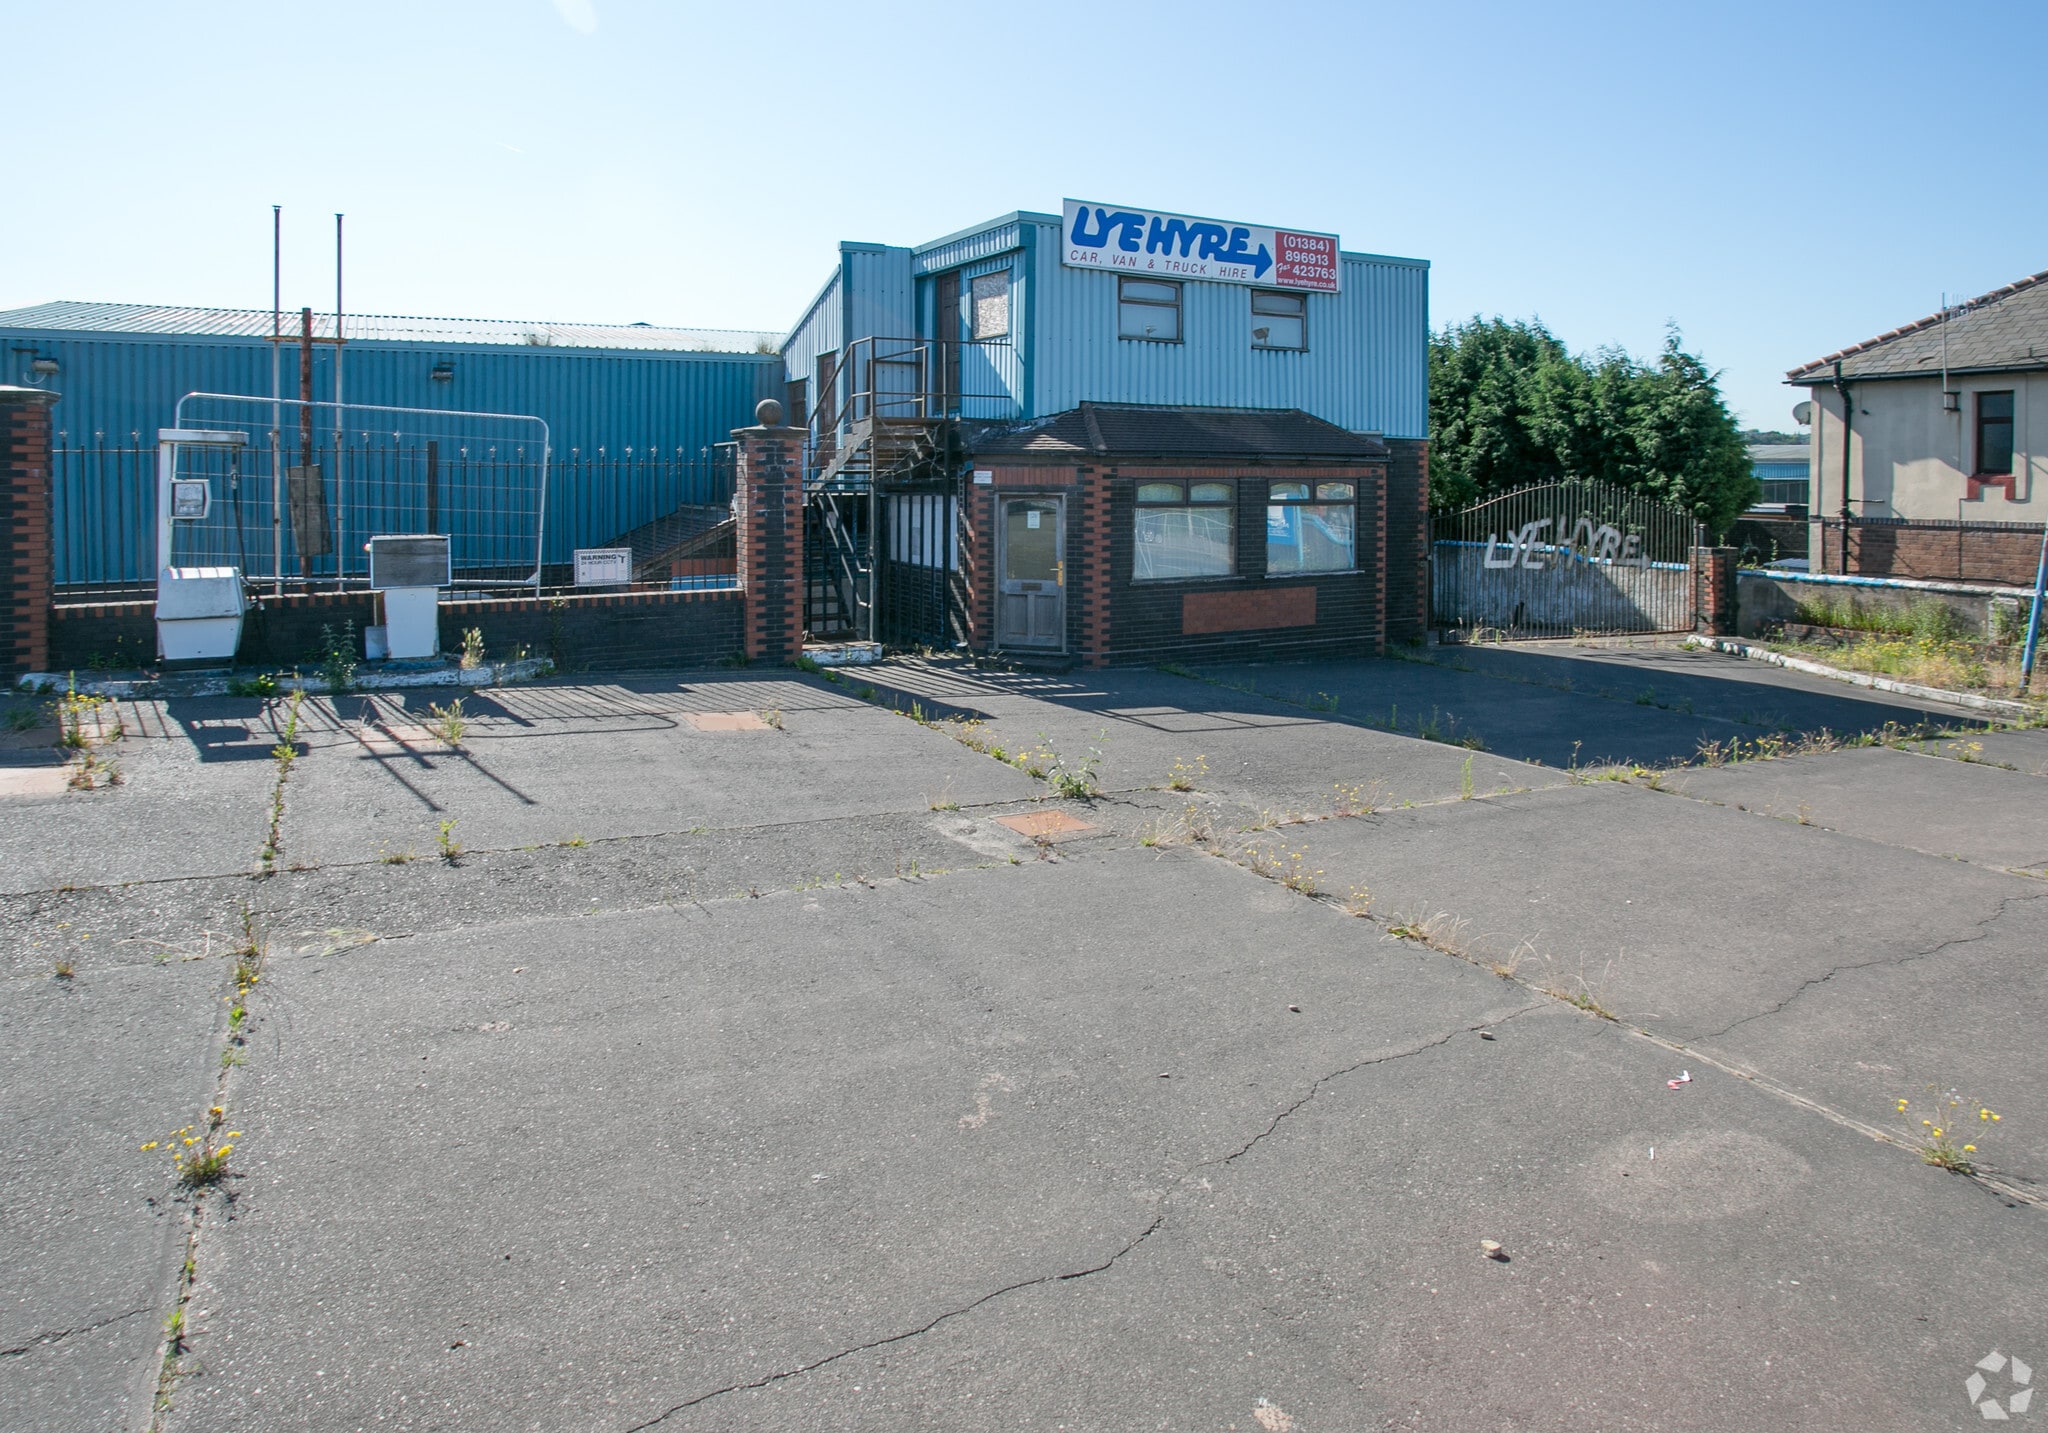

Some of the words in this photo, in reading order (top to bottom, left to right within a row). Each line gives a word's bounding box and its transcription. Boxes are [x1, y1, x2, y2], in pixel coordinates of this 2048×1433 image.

[1283, 234, 1330, 253] (01384)
[1070, 250, 1102, 264] CAR,
[1112, 254, 1137, 267] VAN
[1147, 259, 1155, 269] &
[1165, 260, 1207, 275] TRUCK
[1219, 267, 1248, 279] HIRE
[1285, 250, 1329, 266] 896913
[1292, 265, 1336, 280] 423763
